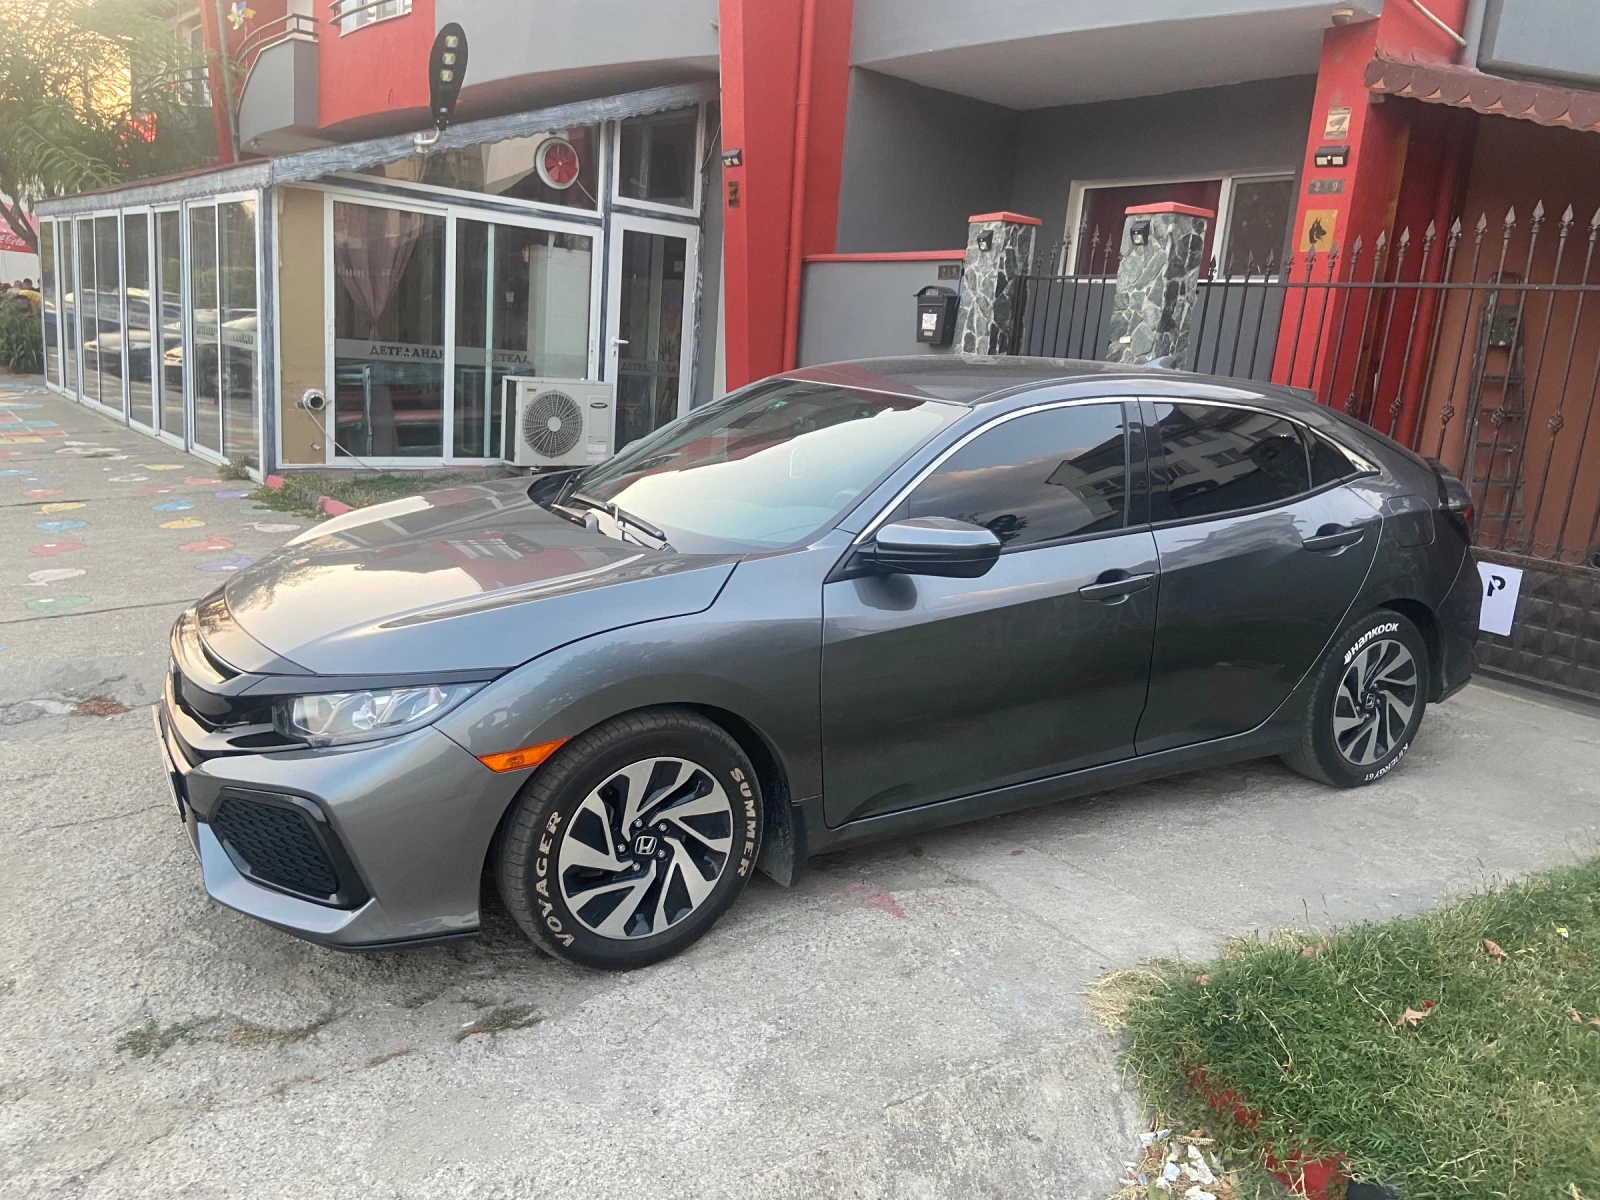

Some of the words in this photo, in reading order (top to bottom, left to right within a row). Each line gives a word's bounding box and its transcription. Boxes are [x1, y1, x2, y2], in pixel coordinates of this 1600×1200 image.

[1486, 574, 1507, 597] P
[1364, 773, 1375, 782] GT
[729, 767, 757, 877] SUMMER
[535, 811, 575, 948] VOYAGER
